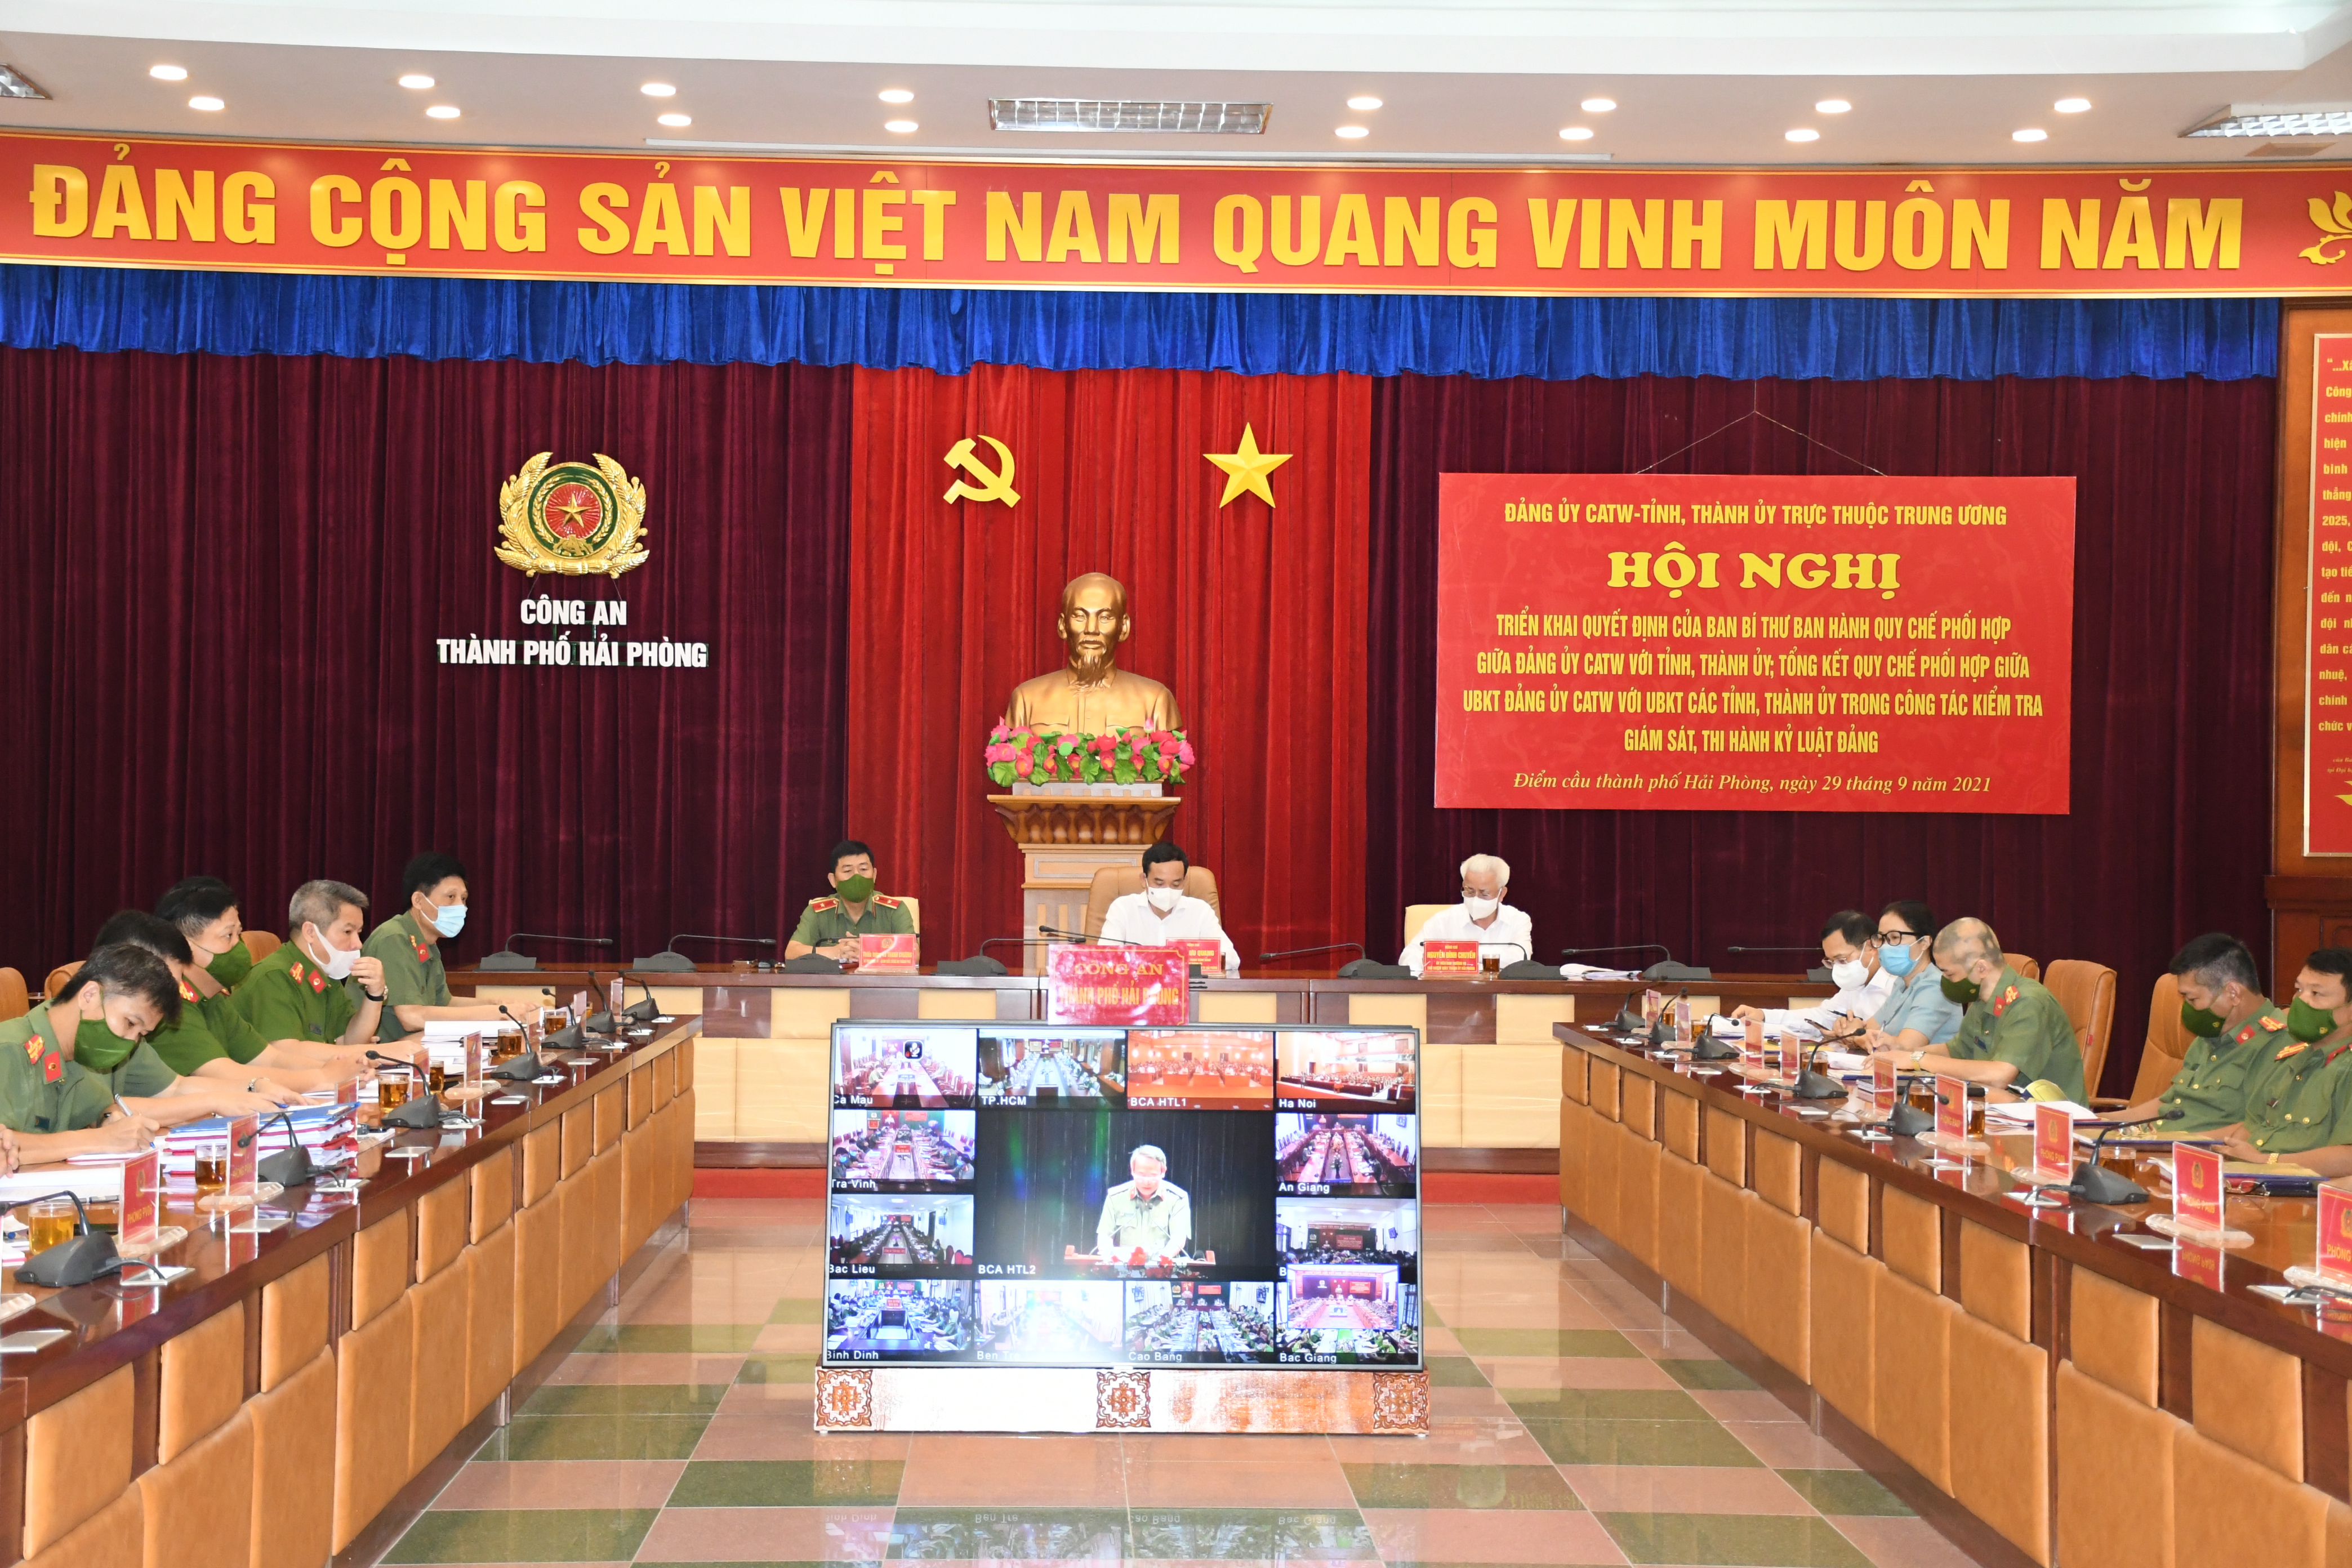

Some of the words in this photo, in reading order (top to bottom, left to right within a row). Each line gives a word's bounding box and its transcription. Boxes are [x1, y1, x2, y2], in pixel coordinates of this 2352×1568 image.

[29, 144, 276, 244] ĐẢNG
[310, 158, 546, 265] CỘNG
[577, 161, 751, 257] SẢN
[779, 171, 957, 276] VIỆT
[986, 190, 1180, 264] NAM
[1213, 194, 1498, 274] QUANG
[1527, 197, 1722, 270] VINH
[1753, 179, 2010, 271] MUÔN
[2040, 178, 2243, 270] NĂM
[2326, 386, 2352, 398] Công
[2324, 438, 2347, 451] hiện
[2323, 487, 2351, 501] thẳng
[1505, 497, 1553, 522] ĐẢNG
[1558, 497, 1580, 523] ỦY
[1586, 497, 1686, 525] CATW-TỈNH,
[1691, 500, 1749, 524] THÀNH
[1754, 497, 1777, 524] ỦY
[1782, 502, 1827, 529] TRỰC
[1832, 502, 1889, 528] THUỘC
[1895, 506, 1953, 525] TRUNG
[1958, 505, 2007, 525] ƯƠNG
[2322, 515, 2351, 527] 2025,
[2322, 541, 2341, 554] đội,
[1607, 541, 1720, 598] HỘI
[1739, 553, 1901, 600] NGHỊ
[2321, 567, 2337, 580] tạo
[2321, 590, 2340, 603] đến
[521, 594, 585, 625] CÔNG
[593, 601, 626, 625] AN
[1496, 605, 1539, 636] TRIỂN
[1543, 614, 1578, 636] KHAI
[1583, 608, 1628, 639] QUYẾT
[1632, 615, 1668, 642] ĐỊNH
[1673, 609, 1702, 638] CỦA
[1707, 616, 1738, 638] BAN
[1742, 612, 1757, 638] BÍ
[1761, 614, 1791, 638] THƯ
[1793, 617, 1824, 639] BAN
[1829, 612, 1870, 639] HÀNH
[1874, 617, 1903, 641] QUY
[1908, 609, 1936, 639] CHẾ
[1941, 609, 1976, 639] PHỐI
[1981, 616, 2011, 643] HỢP
[2320, 618, 2337, 631] đội
[437, 634, 515, 664] THÀNH
[524, 631, 573, 665] PHỐ
[580, 630, 618, 666] HẢI
[627, 636, 706, 667] PHÒNG
[2320, 644, 2339, 654] dân
[1477, 650, 1512, 674] GIỮA
[1516, 646, 1557, 674] ĐẢNG
[1561, 647, 1580, 674] ỦY
[1584, 653, 1625, 675] CATW
[1629, 649, 1653, 675] VỚI
[1657, 647, 1695, 676] TỈNH,
[1700, 649, 1749, 676] THÀNH
[1753, 647, 1774, 678] ỦY;
[1779, 645, 1818, 676] TỔNG
[1822, 648, 1849, 676] KẾT
[1854, 655, 1883, 679] QUY
[1887, 648, 1916, 678] CHẾ
[1921, 648, 1955, 678] PHỐI
[1960, 654, 1990, 681] HỢP
[1995, 652, 2030, 678] GIỮA
[2319, 669, 2347, 682] nhuệ,
[1464, 690, 1501, 711] UBKT
[1504, 683, 1545, 712] ĐẢNG
[1550, 685, 1569, 712] ỦY
[1573, 691, 1614, 712] CATW
[1618, 687, 1642, 713] VỚI
[1646, 692, 1684, 713] UBKT
[1688, 687, 1717, 714] CÁC
[1722, 685, 1760, 716] TỈNH,
[1765, 688, 1814, 714] THÀNH
[1818, 685, 1837, 715] ỦY
[1841, 693, 1890, 715] TRONG
[1895, 689, 1936, 715] CÔNG
[1940, 690, 1968, 716] TÁC
[1973, 685, 2011, 716] KIỂM
[2015, 694, 2043, 716] TRA
[2319, 695, 2347, 706] chính
[2318, 720, 2344, 731] chức
[1624, 726, 1663, 751] GIÁM
[1667, 726, 1698, 752] SÁT,
[1702, 730, 1725, 751] THI
[1729, 725, 1770, 752] HÀNH
[1774, 724, 1793, 752] KỶ
[1798, 727, 1834, 757] LUẬT
[1837, 725, 1878, 753] ĐẢNG
[1514, 770, 1557, 788] Điểm
[1562, 770, 1591, 788] cầu
[1596, 773, 1643, 789] thành
[1647, 772, 1682, 793] phố
[1684, 774, 1714, 789] Hải
[1719, 774, 1774, 793] Phòng,
[1779, 776, 1818, 794] ngày
[1822, 776, 1842, 790] 29
[1846, 776, 1893, 794] tháng
[1897, 776, 1908, 790] 9
[1912, 777, 1947, 791] năm
[1953, 777, 1990, 792] 2021
[1075, 960, 1129, 975] CÔNG
[1136, 964, 1164, 975] AN
[1098, 981, 1119, 1005] PHỐ
[1121, 980, 1139, 1005] HẢI
[850, 1095, 873, 1104] Mau
[981, 1095, 1027, 1106] TP.HCM
[1130, 1098, 1155, 1107] BCA
[1159, 1098, 1187, 1107] HTL1
[1279, 1099, 1294, 1108] Ha
[1298, 1099, 1316, 1108] Noi
[849, 1179, 876, 1188] Vinh
[1279, 1182, 1294, 1192] An
[1298, 1182, 1330, 1193] Giang
[2327, 1243, 2351, 1262] PHÒNG
[852, 1264, 876, 1273] Lieu
[978, 1264, 1003, 1274] BCA
[1007, 1265, 1036, 1275] HTL2
[853, 1350, 879, 1360] Dinh
[977, 1351, 998, 1360] Ben
[1129, 1352, 1151, 1361] Cao
[1154, 1352, 1183, 1363] Bang
[1279, 1353, 1300, 1362] Bac
[1304, 1353, 1337, 1364] Giang
